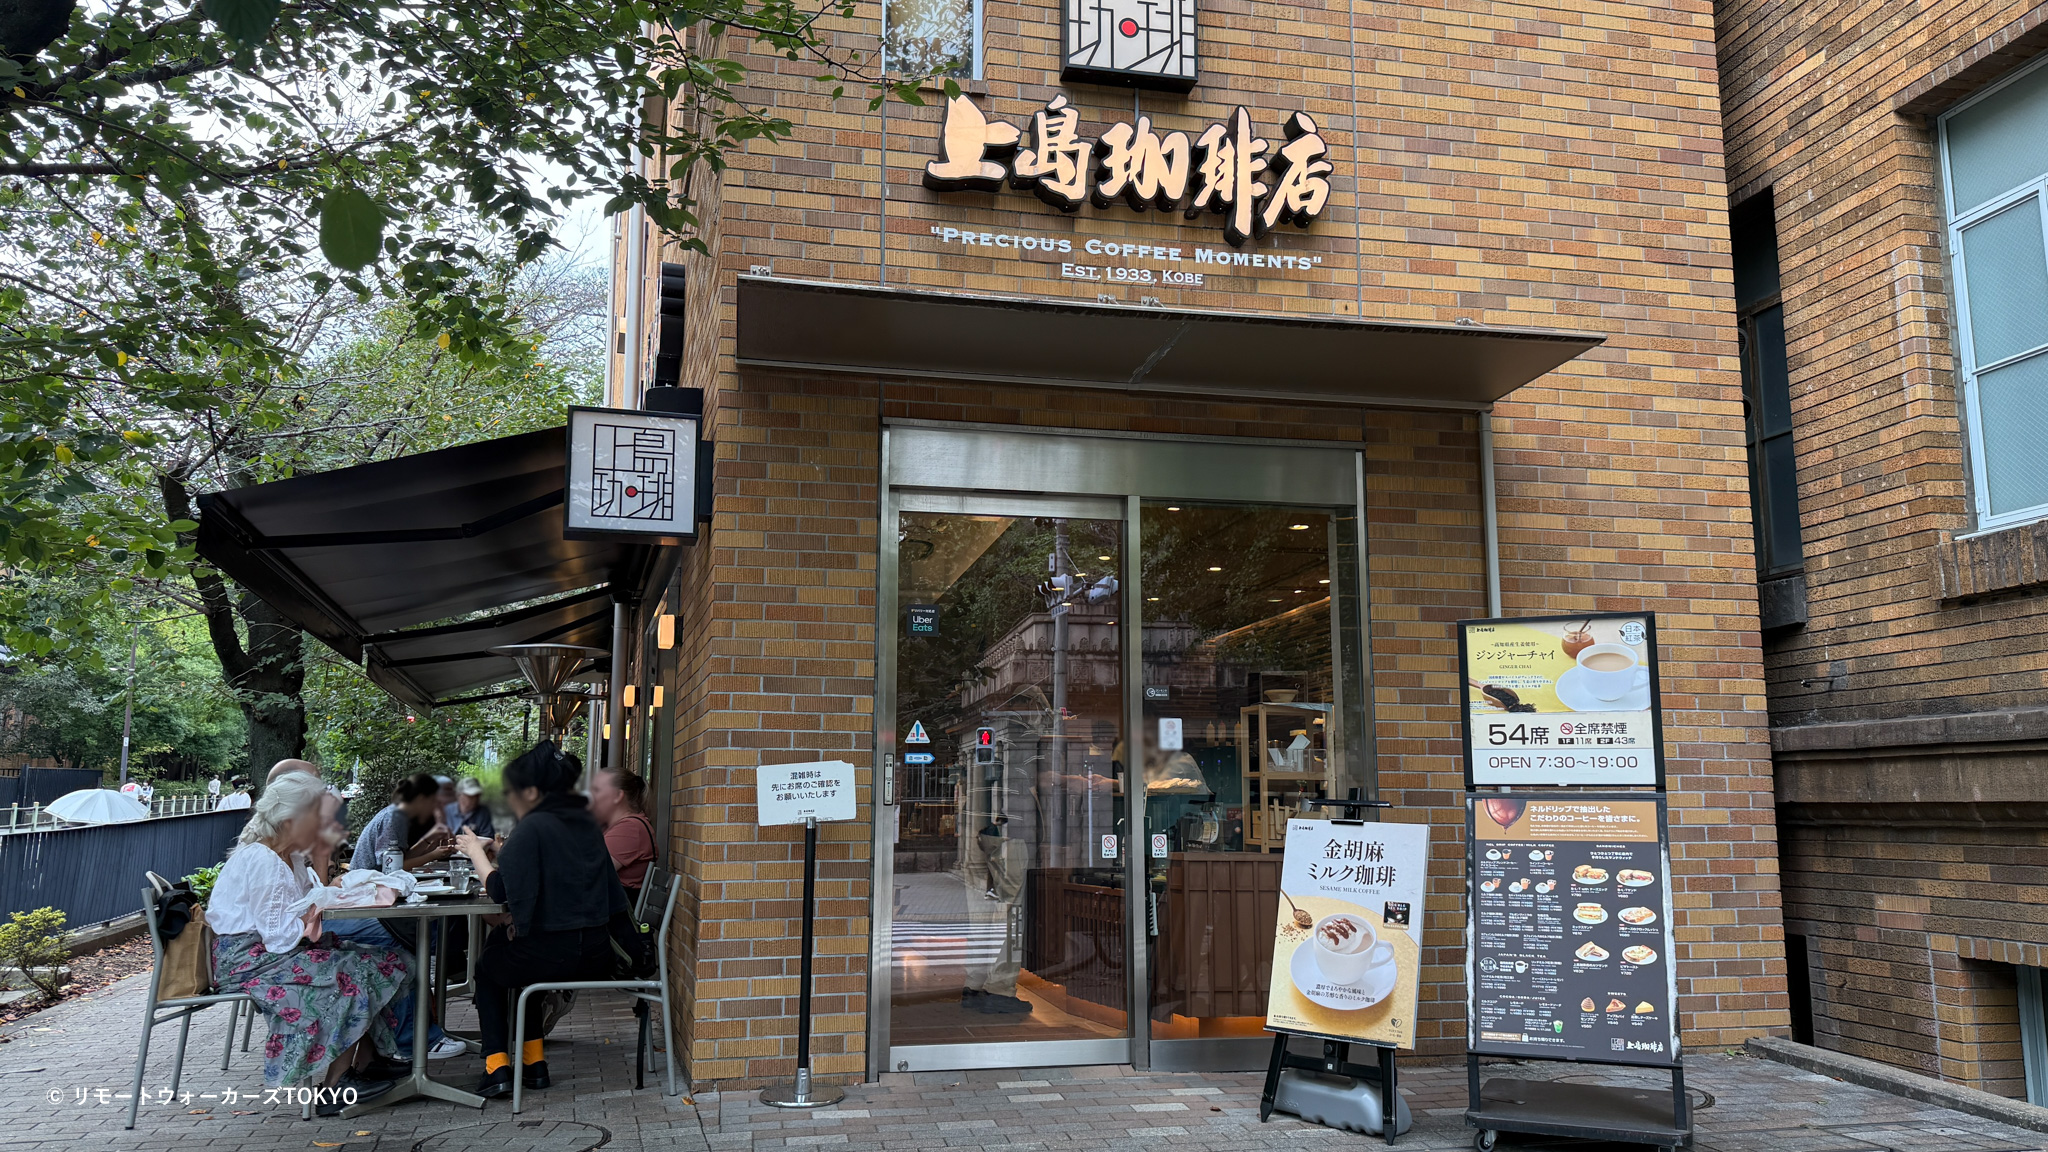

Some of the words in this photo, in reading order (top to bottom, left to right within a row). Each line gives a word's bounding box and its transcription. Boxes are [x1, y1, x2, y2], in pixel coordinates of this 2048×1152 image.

[924, 93, 1334, 246] 上島珈琲店
[912, 615, 933, 624] Uber
[912, 624, 933, 632] Eats
[1476, 650, 1555, 661] ジンジャーチャイ
[1488, 723, 1550, 746] 54席
[1574, 722, 1627, 735] 全席禁煙
[1489, 757, 1531, 769] OPEN
[790, 771, 821, 780] 混雑時は
[771, 779, 841, 792] 先にお席のご確認を
[776, 789, 837, 801] お願いいたします
[1530, 805, 1611, 813] ネルドリップで抽出した
[1530, 814, 1641, 823] こだわりのコーヒーを皆さまに。
[1322, 838, 1385, 863] 金胡麻
[1307, 862, 1397, 888] ミルク珈琲
[1319, 885, 1342, 893] SESAME
[1626, 1040, 1664, 1053] 上島珈琲店
